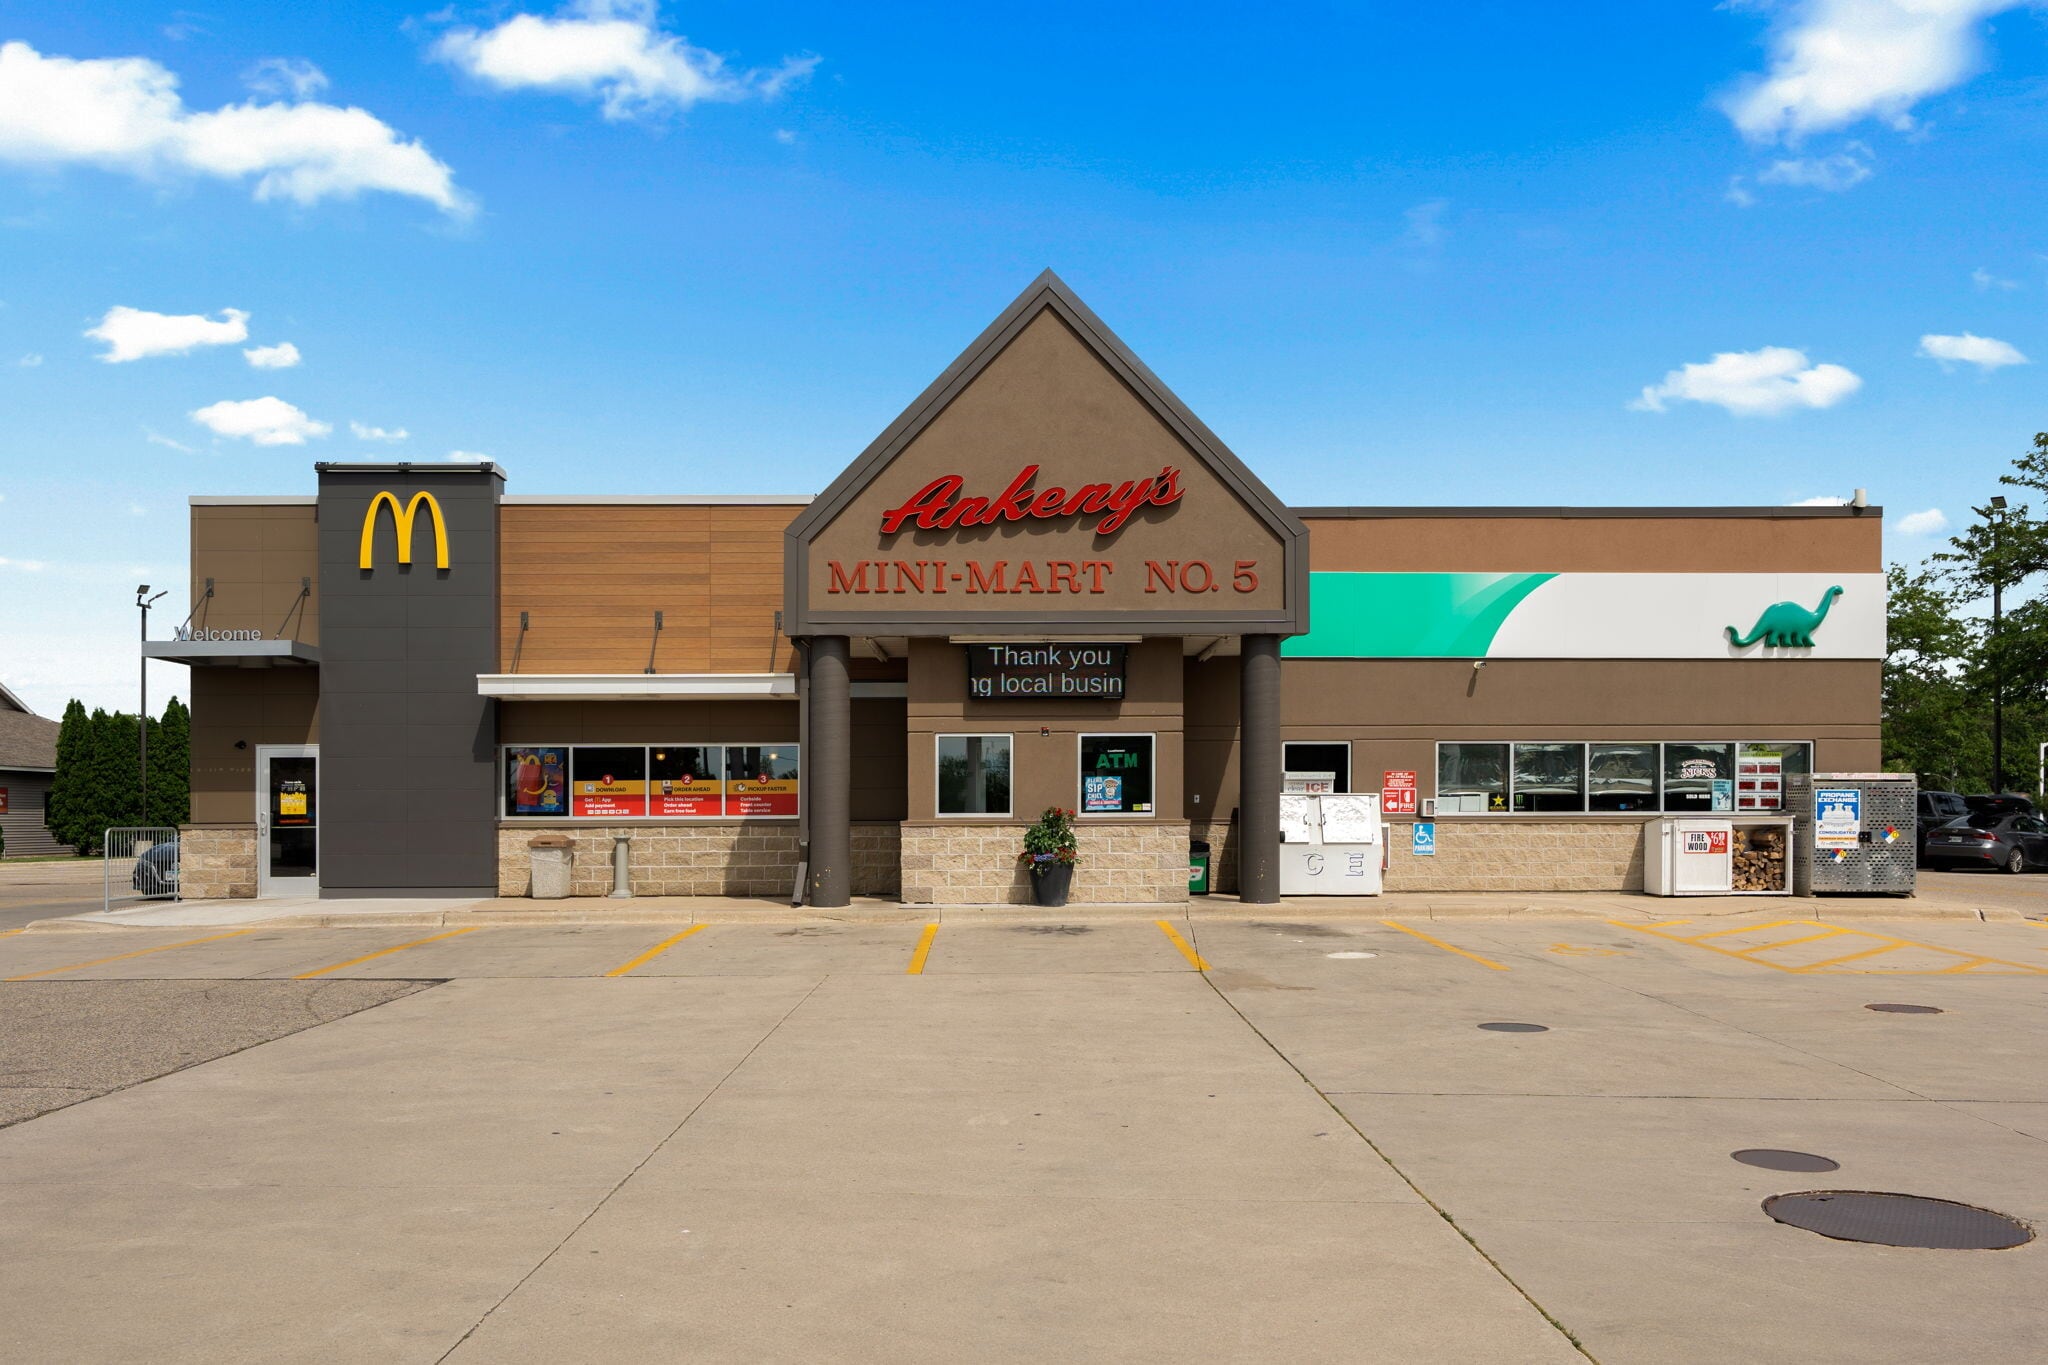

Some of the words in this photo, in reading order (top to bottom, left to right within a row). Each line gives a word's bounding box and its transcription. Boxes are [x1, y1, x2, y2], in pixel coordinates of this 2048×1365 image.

[881, 464, 1187, 535] Ankeny's
[827, 560, 1114, 593] MINI-MART
[1144, 560, 1220, 593] NO.
[1233, 560, 1259, 593] 5
[174, 626, 262, 641] Welcome
[988, 645, 1062, 666] Thank
[1069, 650, 1111, 670] you
[1001, 673, 1053, 693] local
[1061, 673, 1122, 693] busin
[1096, 753, 1138, 768] ATM
[606, 776, 610, 784] 1
[684, 776, 690, 784] 2
[1087, 784, 1102, 793] SIP
[1305, 782, 1329, 793] ICE
[1690, 834, 1704, 842] FIRE
[1688, 842, 1708, 850] WOOD
